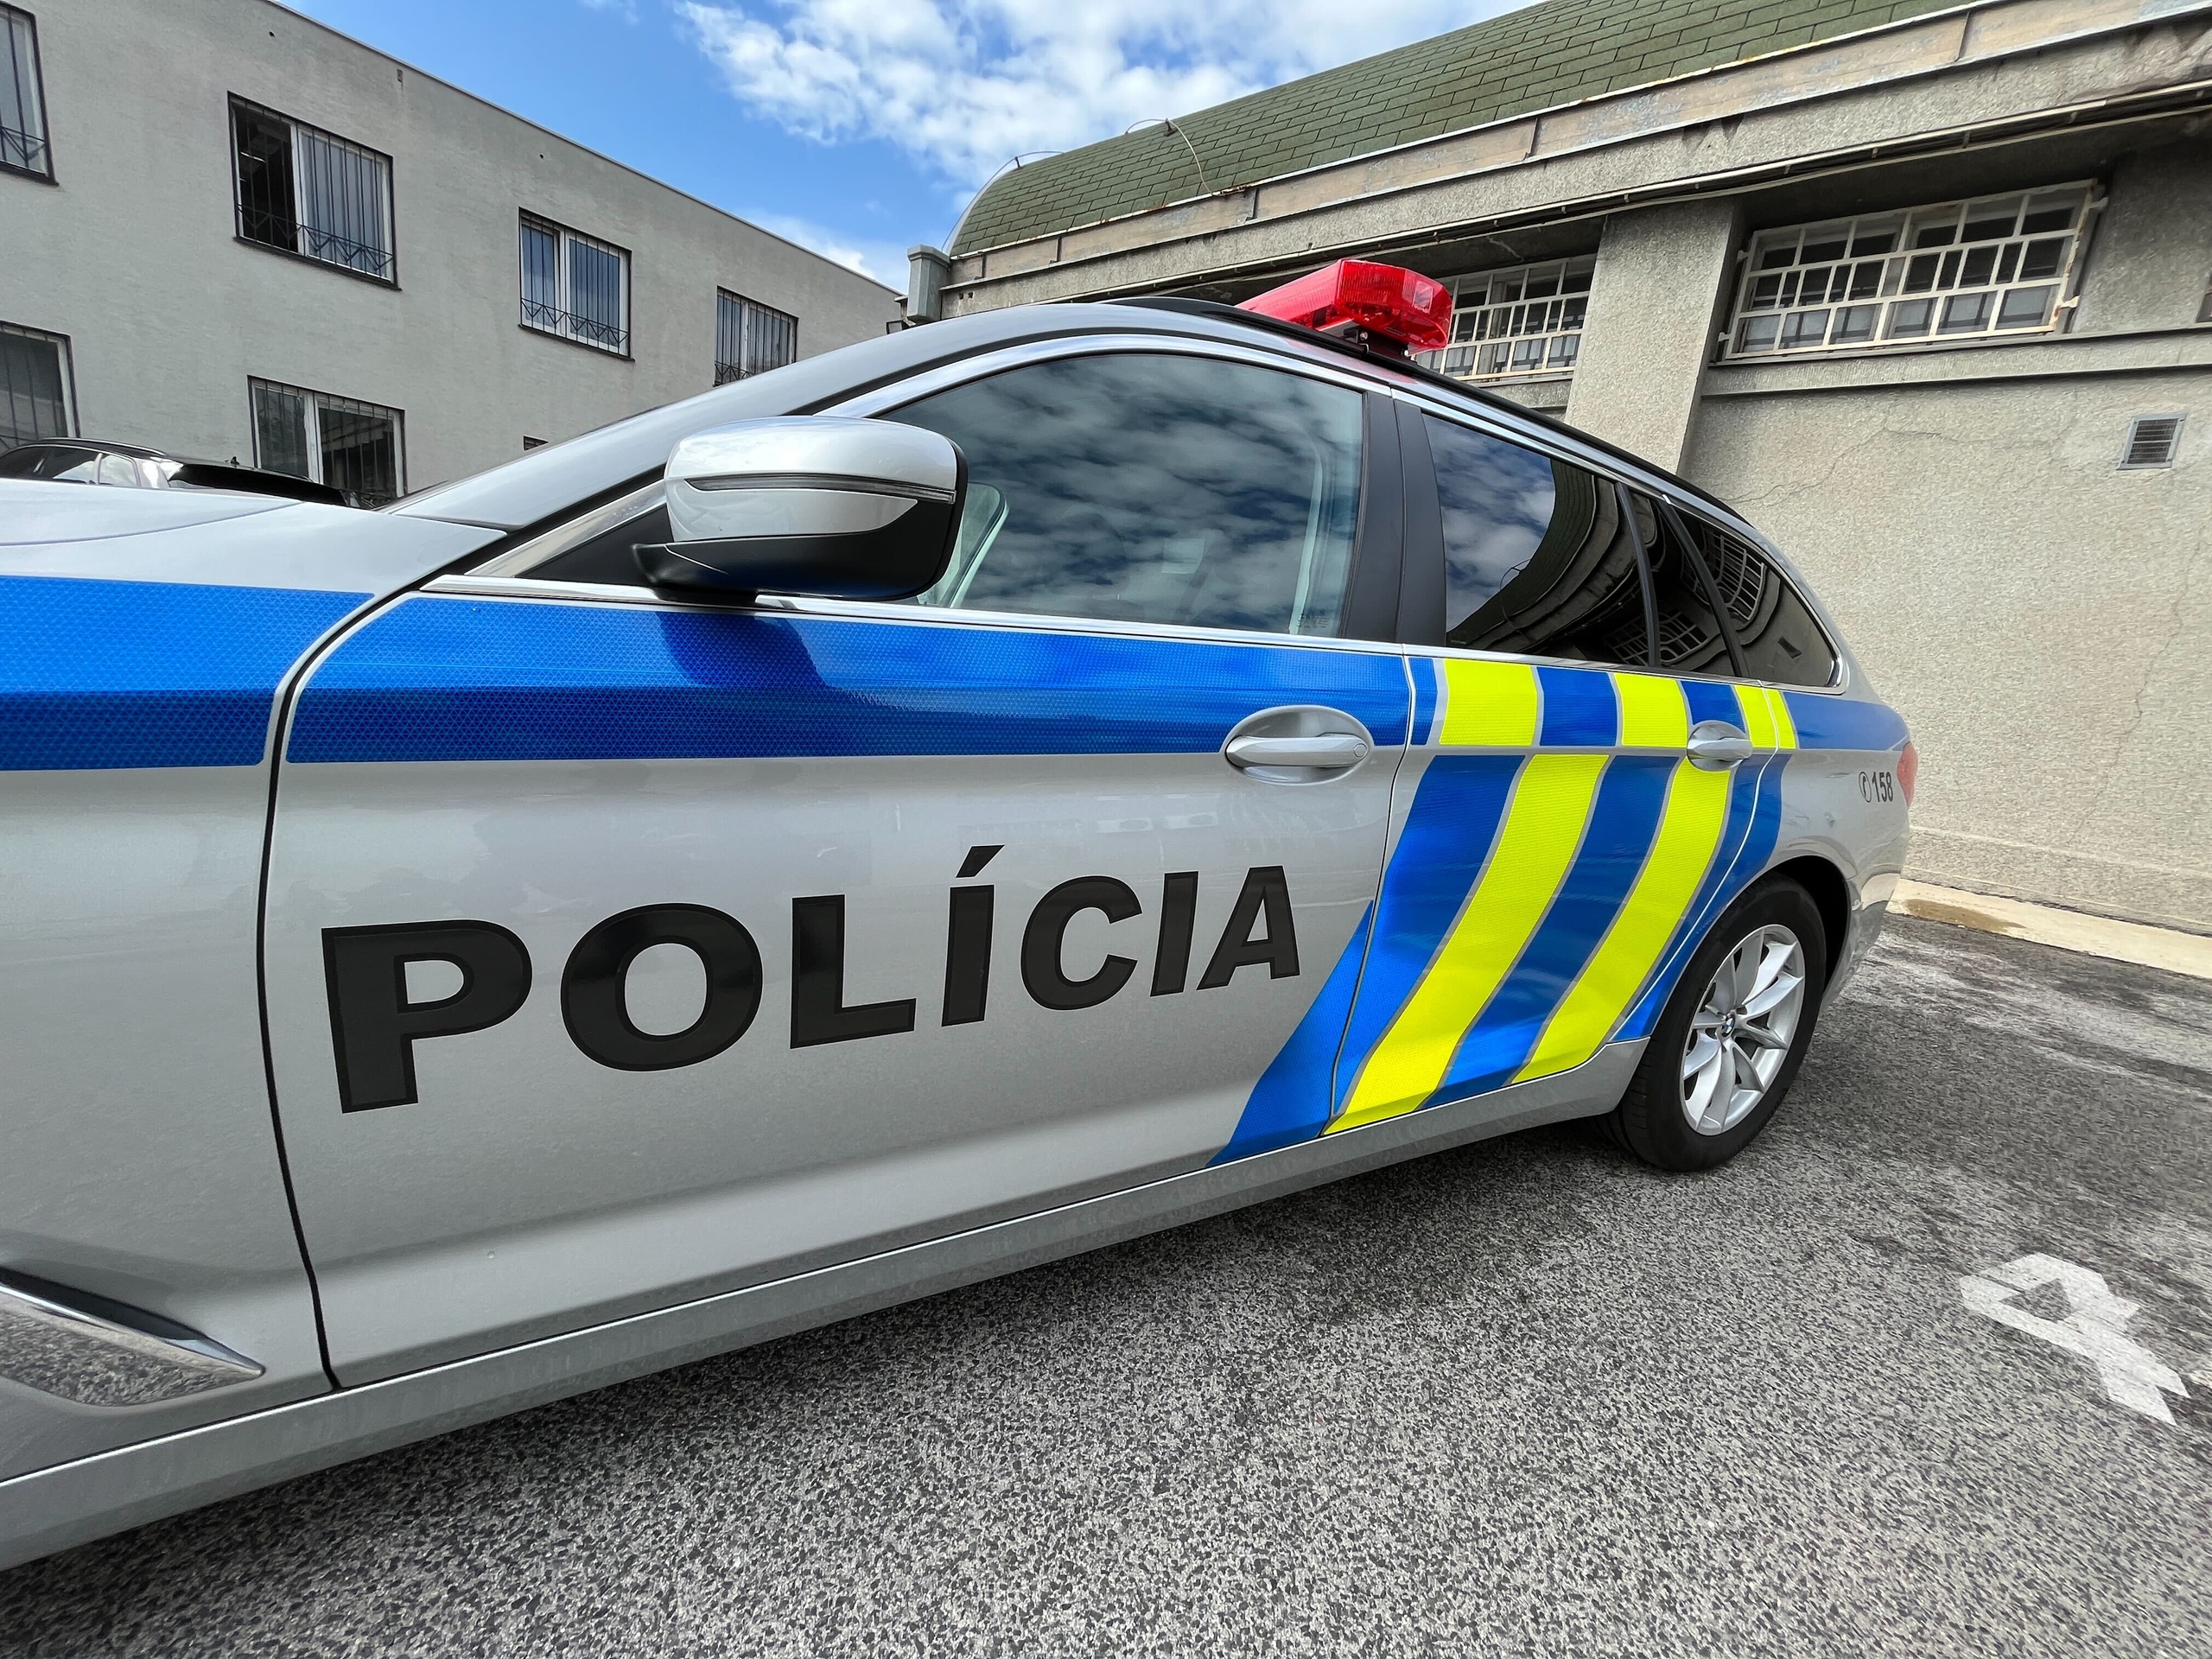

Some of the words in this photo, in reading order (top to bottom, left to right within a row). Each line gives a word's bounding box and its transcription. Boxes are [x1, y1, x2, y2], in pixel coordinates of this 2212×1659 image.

[1871, 771, 1894, 803] 158
[321, 844, 1300, 1115] POLÍCIA
[1959, 1252, 2191, 1426] 4
